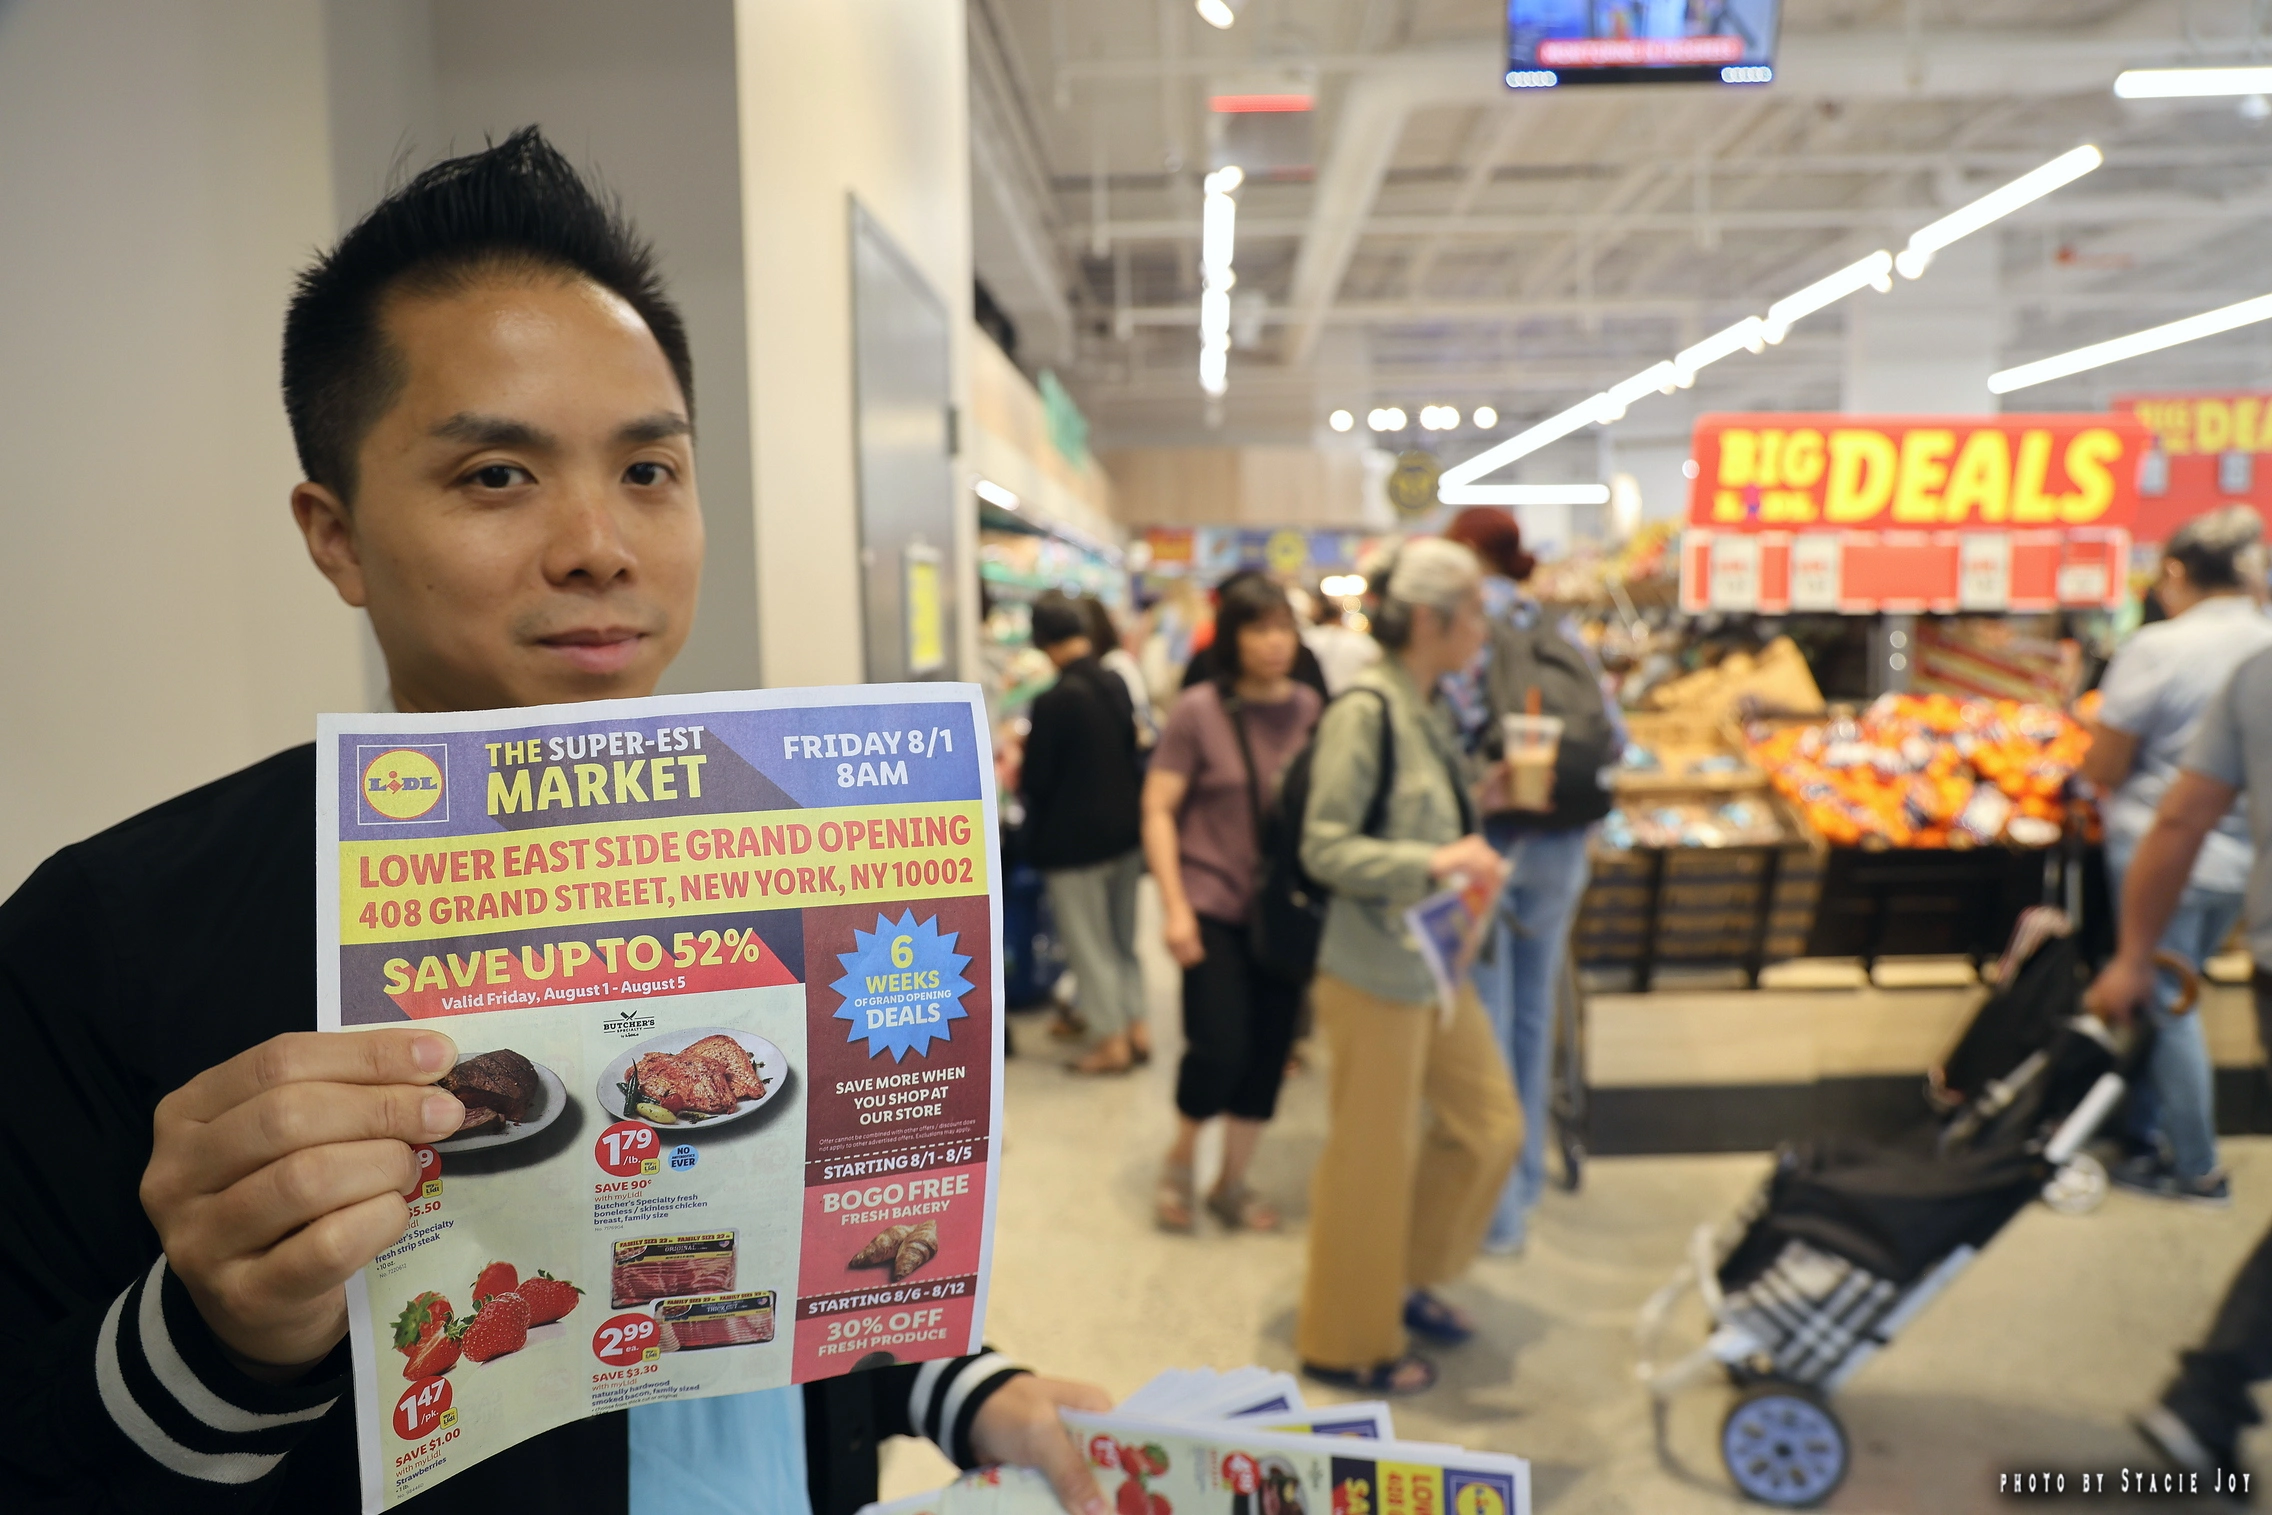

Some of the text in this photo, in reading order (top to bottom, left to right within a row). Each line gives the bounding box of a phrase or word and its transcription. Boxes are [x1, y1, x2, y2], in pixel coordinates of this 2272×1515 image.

[1718, 428, 1827, 488] BIG
[1826, 427, 2124, 523] DEALS
[485, 725, 705, 767] THE SUPER-EST
[783, 727, 953, 760] FRIDAY 8/1
[487, 755, 707, 816] MARKET
[837, 760, 909, 788] 8AM
[359, 814, 972, 889] LOWER EAST SIDE GRAND OPENING
[359, 857, 973, 929] 408 GRAND STREET, NEW YORK, NY 10002
[383, 927, 760, 995] SAVE UP TO 52%
[891, 934, 914, 969] 6
[442, 993, 484, 1010] Valid
[487, 989, 541, 1007] Friday,
[543, 985, 600, 1002] August
[602, 983, 610, 995] 1
[621, 978, 675, 996] August
[677, 976, 686, 989] 5
[865, 970, 941, 994] WEEKS
[854, 990, 952, 1008] OF GRAND OPENING
[603, 1020, 655, 1031] BUTCHER'S
[866, 1002, 941, 1030] DEALS
[835, 1066, 966, 1095] SAVE MORE WHEN
[854, 1086, 949, 1110] YOU SHOP AT
[859, 1103, 942, 1125] OUR STORE
[834, 1134, 854, 1143] cannot
[863, 1129, 891, 1140] combined
[891, 1127, 904, 1136] with
[904, 1125, 918, 1134] other
[939, 1119, 963, 1129] discount
[853, 1139, 868, 1147] other
[868, 1136, 897, 1146] advertised
[915, 1129, 943, 1140] Exclusions
[671, 1158, 695, 1168] EVER
[677, 1147, 690, 1155] NO
[823, 1154, 908, 1180] STARTING
[910, 1151, 935, 1170] 8/1
[946, 1146, 973, 1165] 8/5
[594, 1191, 642, 1202] with myLidl
[595, 1181, 628, 1194] SAVE
[822, 1174, 970, 1213] BOGO FREE
[594, 1193, 698, 1211] Butcher's Specialty fresh
[594, 1208, 633, 1218] boneless
[639, 1204, 674, 1213] skinless
[674, 1200, 708, 1209] chicken
[841, 1200, 950, 1226] FRESH BAKERY
[405, 1219, 419, 1231] idl
[413, 1220, 454, 1238] Specialty
[593, 1211, 669, 1226] breast, family size
[375, 1233, 441, 1263] fresh strip steak
[808, 1292, 892, 1315] STARTING
[893, 1286, 921, 1303] 8/6
[932, 1281, 965, 1299] 8/12
[827, 1308, 944, 1342] 30% OFF
[818, 1327, 947, 1357] FRESH PRODUCE
[592, 1364, 658, 1383] SAVE $3.30
[592, 1383, 610, 1391] with
[592, 1380, 670, 1399] naturally hardwood
[592, 1396, 624, 1407] smoked
[652, 1385, 679, 1395] family
[678, 1384, 700, 1392] sized
[395, 1428, 461, 1468] SAVE $1.00
[395, 1450, 441, 1477] with myLidl
[396, 1456, 447, 1487] Strawberries
